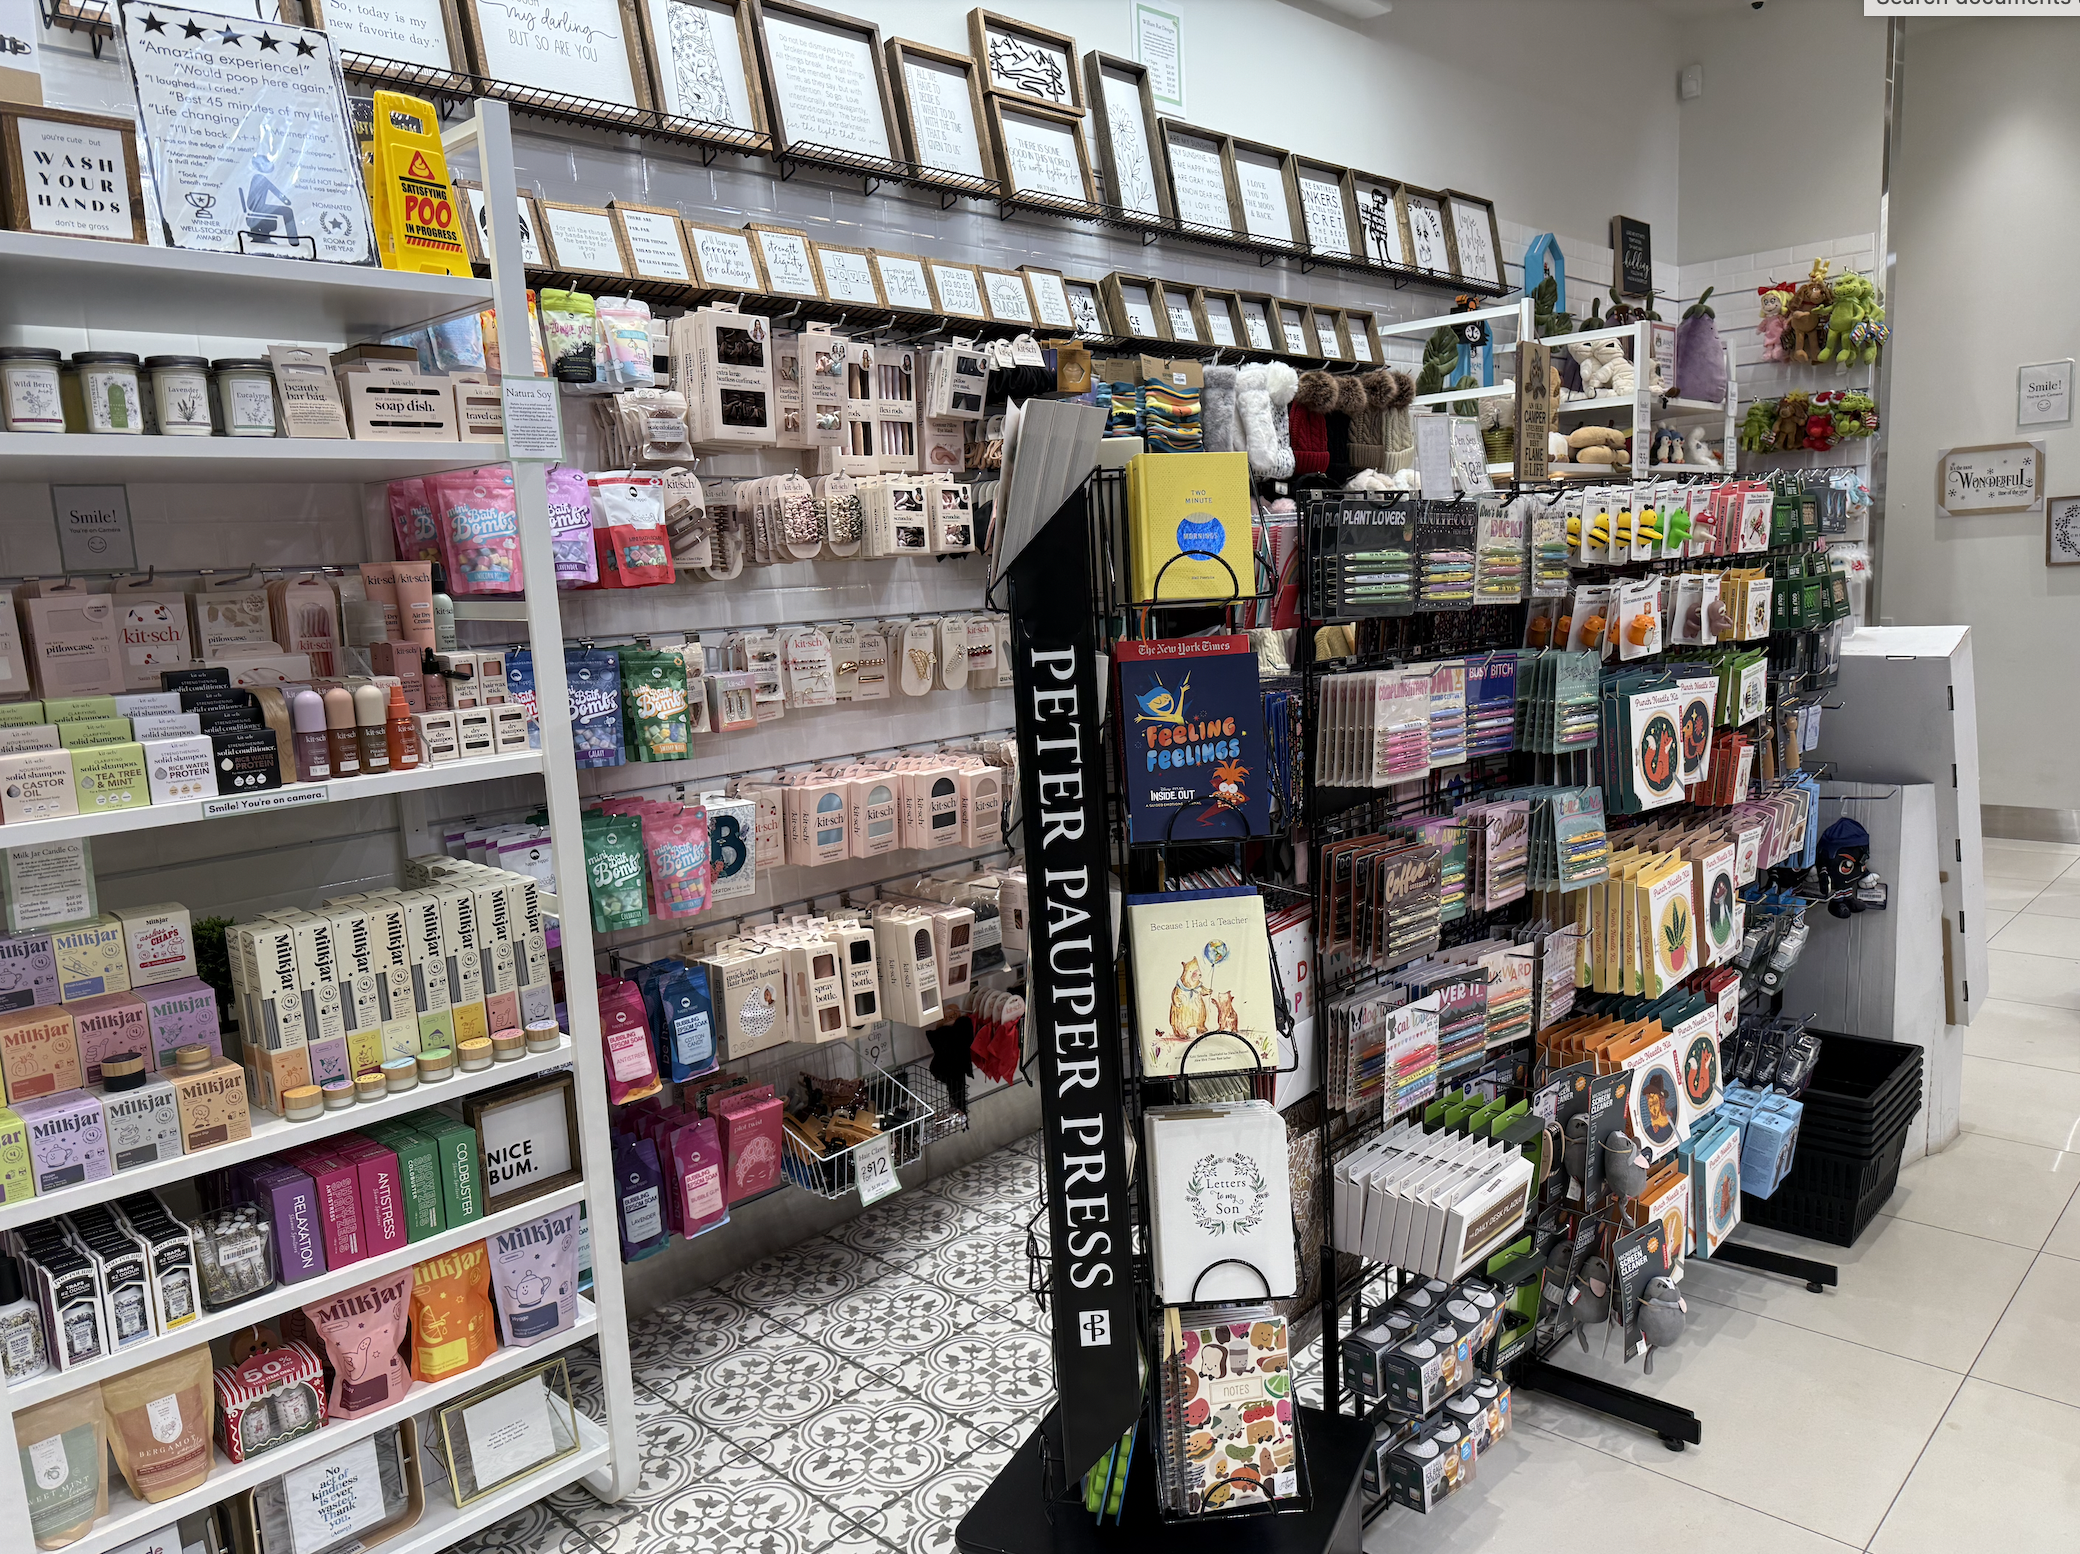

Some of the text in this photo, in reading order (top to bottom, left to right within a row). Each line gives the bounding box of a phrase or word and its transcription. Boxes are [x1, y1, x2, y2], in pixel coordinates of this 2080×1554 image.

[357, 5, 390, 22] today
[395, 11, 406, 23] is
[409, 16, 427, 30] my
[328, 18, 353, 30] new
[358, 23, 405, 41] favorite
[508, 28, 598, 62] BUT SO ARE YOU
[140, 39, 309, 76] “Amazing experience!”
[227, 72, 258, 88] poop
[263, 76, 288, 89] here
[206, 97, 223, 107] 45
[228, 101, 274, 115] minutes
[278, 107, 290, 117] of
[294, 111, 310, 123] my
[33, 151, 113, 172] WASH
[38, 172, 114, 193] YOUR
[402, 182, 448, 200] SATISFYING
[1248, 190, 1268, 200] YOU TO
[38, 194, 120, 213] HANDS
[1245, 199, 1275, 211] THE MOON
[405, 196, 451, 229] POO
[55, 220, 74, 228] don't
[89, 223, 109, 231] gross
[180, 226, 234, 235] WELL-STOCKED
[406, 222, 457, 241] IN PROGRESS
[14, 380, 52, 389] Wild Berry
[284, 382, 320, 392] beauty
[2029, 380, 2062, 393] Smile!
[90, 375, 98, 416] CITRONELLA
[236, 391, 270, 400] Eucalyptus
[286, 392, 300, 400] bar
[506, 388, 552, 400] Natura Soy
[375, 400, 435, 412] soap dish.
[1525, 411, 1546, 424] CAMPER
[1525, 448, 1543, 461] FLAME
[1530, 463, 1544, 476] LIFE
[70, 509, 117, 524] Smile!
[446, 503, 468, 517] mini
[468, 508, 498, 521] Bath
[1343, 509, 1406, 526] PLANT LOVERS
[451, 511, 517, 543] Bombs
[1491, 520, 1522, 538] DICK!
[1183, 532, 1218, 540] MORNINGS
[1138, 641, 1231, 656] The New York Times
[1469, 662, 1514, 678] BUSY BITCH
[1635, 692, 1679, 707] Punch Needle Kit
[96, 769, 142, 780] TEA TREE
[170, 767, 210, 778] PROTEIN
[23, 779, 64, 789] CASTOR
[106, 778, 133, 787] MINT
[23, 788, 42, 797] OIL
[1150, 789, 1195, 802] INSIDE OUT
[209, 802, 239, 813] Smile!
[241, 798, 270, 809] You're
[287, 792, 324, 802] camera.
[30, 850, 41, 858] Jar
[42, 847, 66, 855] Candle
[1385, 861, 1426, 902] Coffee
[524, 883, 540, 934] Milkjar
[1150, 922, 1183, 931] Because
[1192, 919, 1208, 927] Had
[1217, 917, 1249, 926] Teacher
[56, 928, 118, 951] Milkjar
[151, 929, 179, 946] CHAPS
[275, 933, 294, 990] Milkjar
[1030, 645, 1114, 1289] PETER PAUPER PRESS
[80, 1009, 143, 1034] Milkjar
[4, 1022, 69, 1048] Milkjar
[610, 1031, 635, 1043] BUBBLING
[611, 1036, 644, 1049] EPSOM SOAK
[685, 1033, 704, 1043] COTTON
[687, 1039, 703, 1048] CANDY
[617, 1052, 645, 1064] ANTISTRESS
[33, 1110, 100, 1140] Milkjar
[487, 1140, 532, 1167] NICE
[859, 1145, 887, 1161] Hair Claws
[489, 1159, 539, 1186] BUM.
[862, 1167, 866, 1175] 2
[863, 1174, 871, 1182] for
[456, 1142, 473, 1217] COLDBUSTER
[1206, 1178, 1246, 1190] Letters
[1215, 1191, 1244, 1204] to my
[378, 1172, 396, 1240] ANTISTRESS
[1216, 1204, 1240, 1214] Son
[1475, 1194, 1523, 1236] DAILY DESK PLAQUE
[293, 1194, 315, 1269] RELAXATION
[496, 1214, 573, 1254] Milkjar
[1620, 1251, 1643, 1268] SCREEN
[1621, 1256, 1648, 1276] CLEANER
[116, 1265, 134, 1274] TRAPS
[121, 1267, 140, 1277] ODOUR
[280, 1367, 295, 1375] ONLY
[1224, 1384, 1250, 1396] NOTES
[139, 1434, 197, 1458] BERGAMOT
[320, 1468, 349, 1490] act of
[326, 1466, 340, 1478] No
[312, 1474, 358, 1501] kindness
[319, 1488, 353, 1507] is ever
[317, 1496, 356, 1515] wasted.
[321, 1501, 356, 1523] Thank
[330, 1515, 350, 1530] you.
